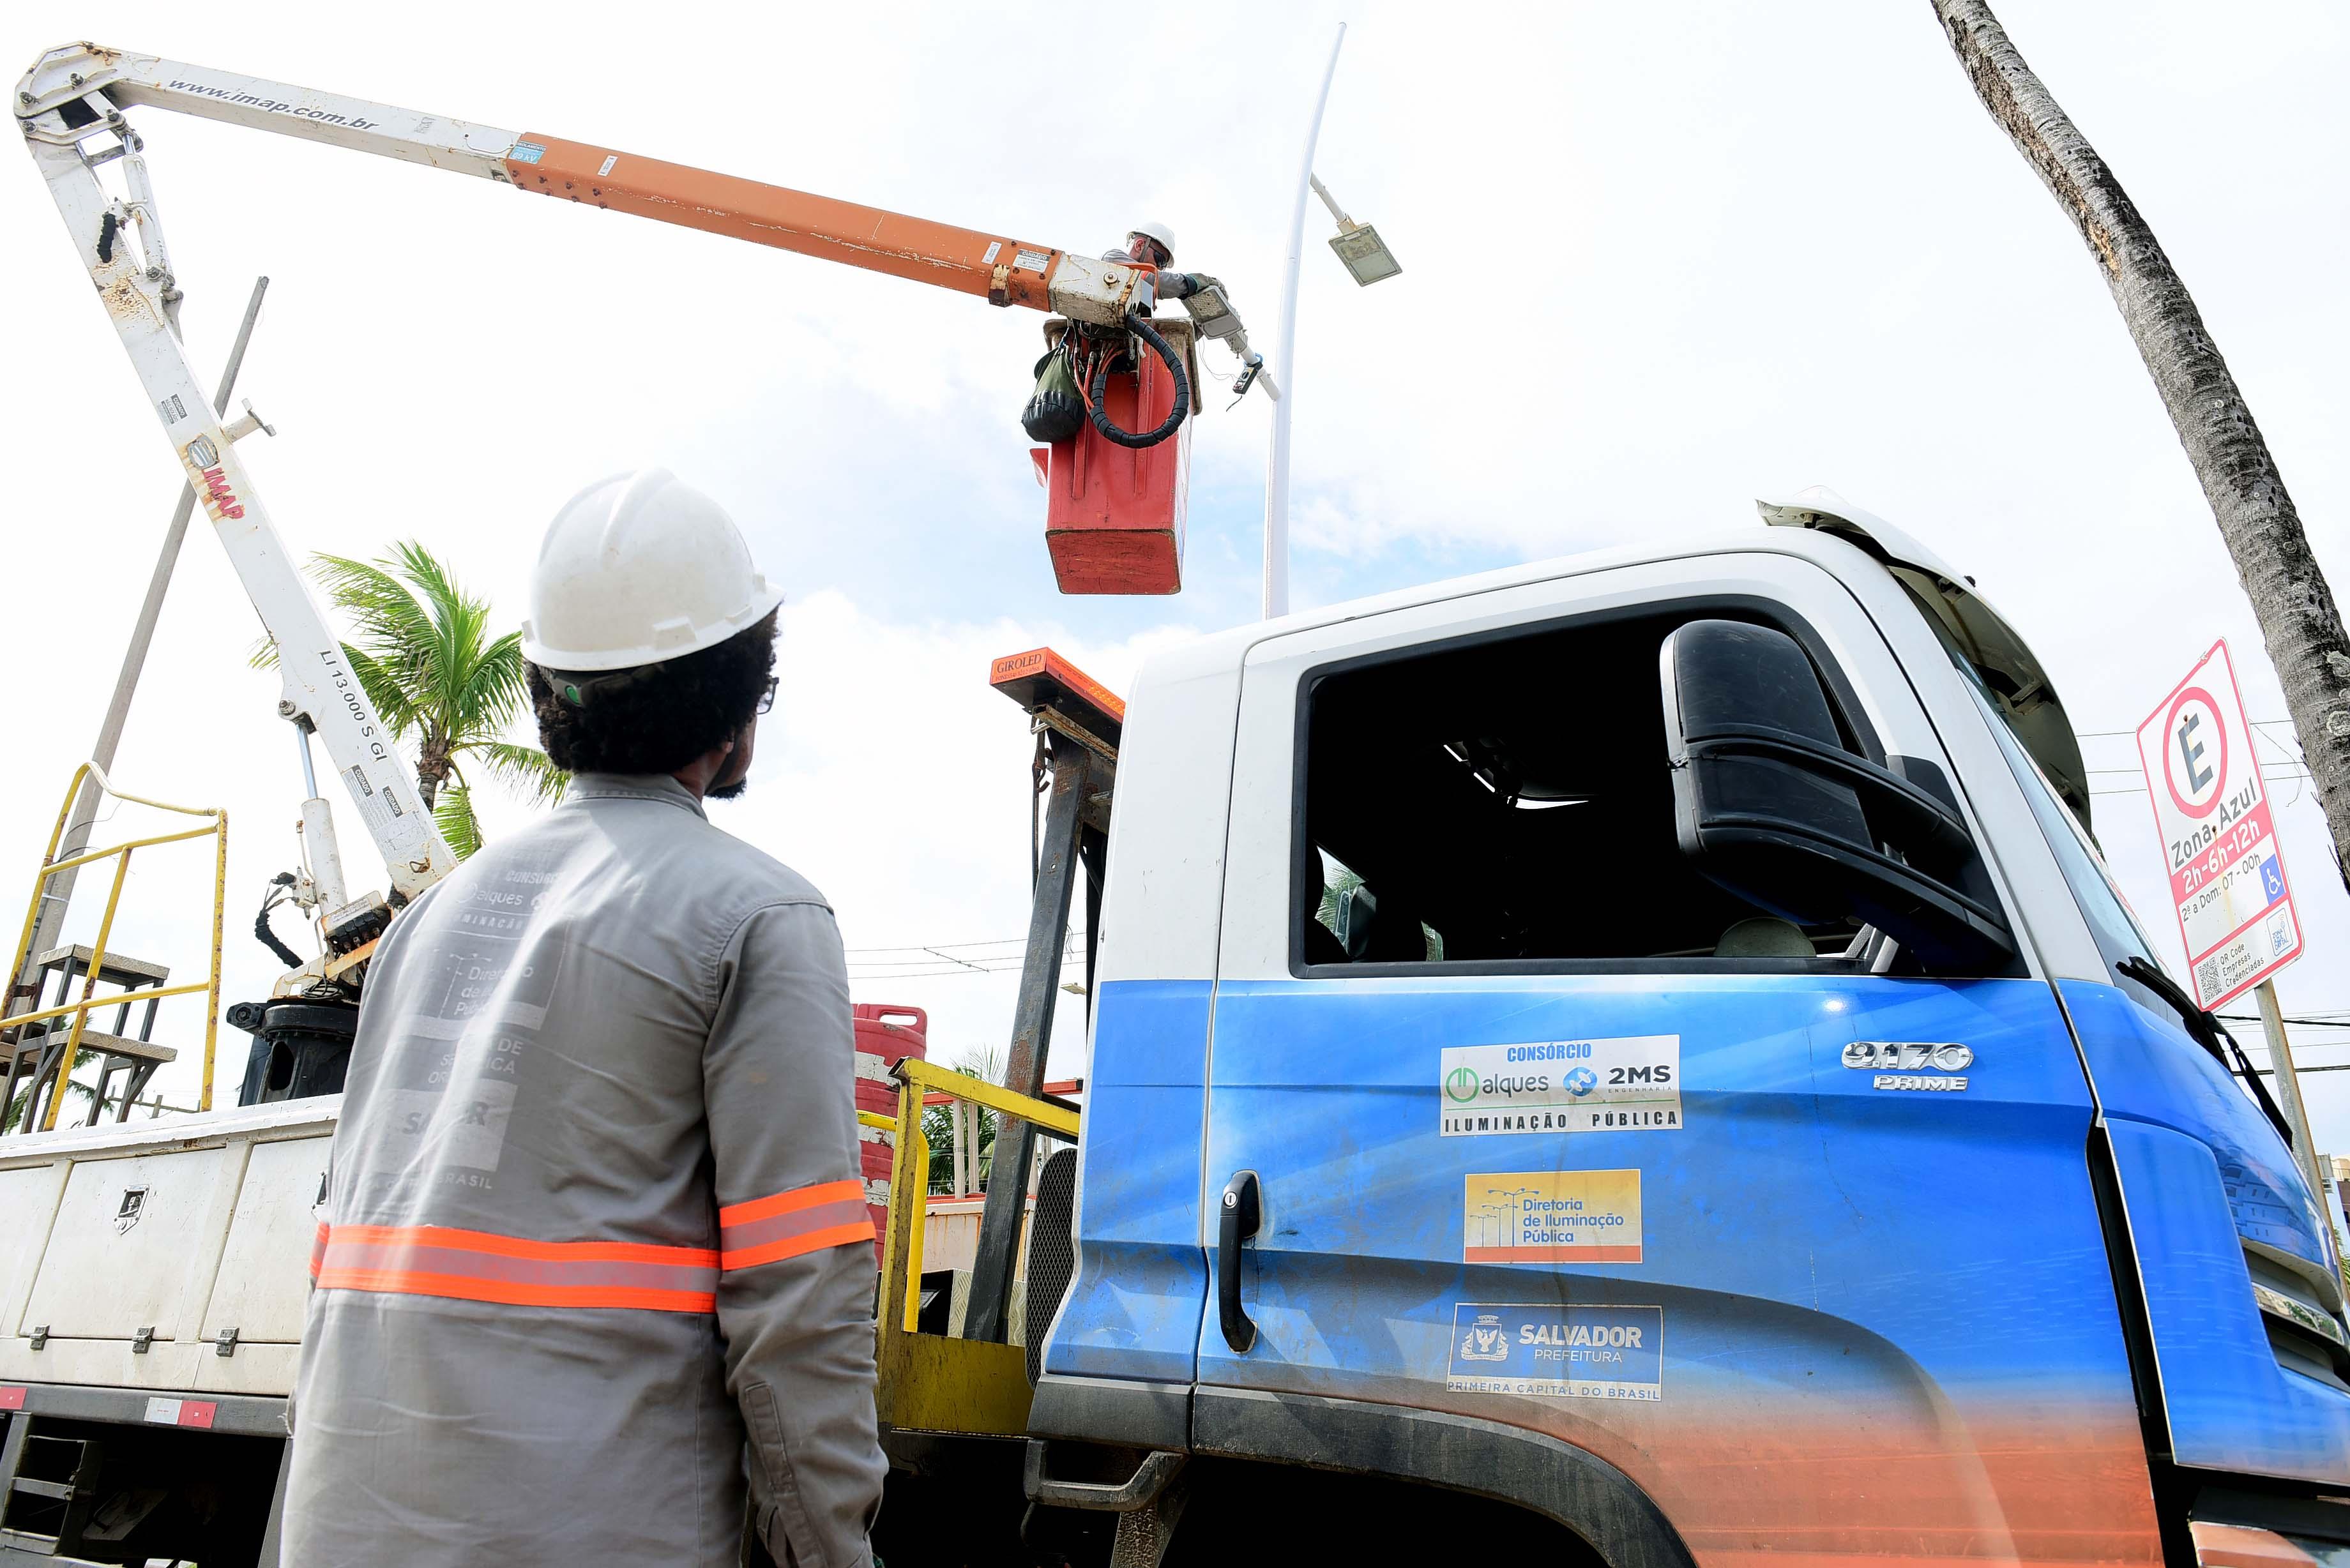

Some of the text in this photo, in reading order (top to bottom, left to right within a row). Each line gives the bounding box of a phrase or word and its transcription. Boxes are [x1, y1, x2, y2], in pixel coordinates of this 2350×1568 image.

[169, 77, 379, 131] www.imap.com.br
[517, 142, 546, 151] ISOLAMENTO
[1022, 250, 1047, 260] CUIDADO
[172, 397, 185, 416] CUIDADO
[204, 467, 245, 519] IMAP
[997, 653, 1042, 674] GIROLED
[319, 650, 388, 762] LI 13.000 S GI
[2178, 713, 2213, 795] E
[354, 768, 370, 794] CUIDADO
[385, 789, 400, 815] CUIDADO
[2171, 776, 2257, 868] Zona Azul
[2193, 903, 2198, 914] a
[2199, 886, 2222, 908] Dom:
[2222, 871, 2233, 890] 07
[2242, 853, 2261, 874] 00h
[2220, 943, 2245, 965] QR Code
[2222, 952, 2251, 976] Empresas
[2225, 958, 2264, 988] Credenciadas
[1507, 1042, 1592, 1062] CONSÓRCIO
[1608, 1065, 1671, 1085] 2MS
[1874, 1076, 1968, 1091] PRIME
[1444, 1110, 1678, 1133] ILUMINAÇÃO PÚBLICA
[1523, 1198, 1583, 1212] Diretoria
[1523, 1212, 1624, 1230] de Iluminação
[1523, 1229, 1574, 1243] Pública
[1518, 1323, 1642, 1348] SALVADOR
[1534, 1349, 1623, 1364] PREFEITURA
[1447, 1382, 1660, 1401] PRIMEIRA CAPITAL DO BRASIL
